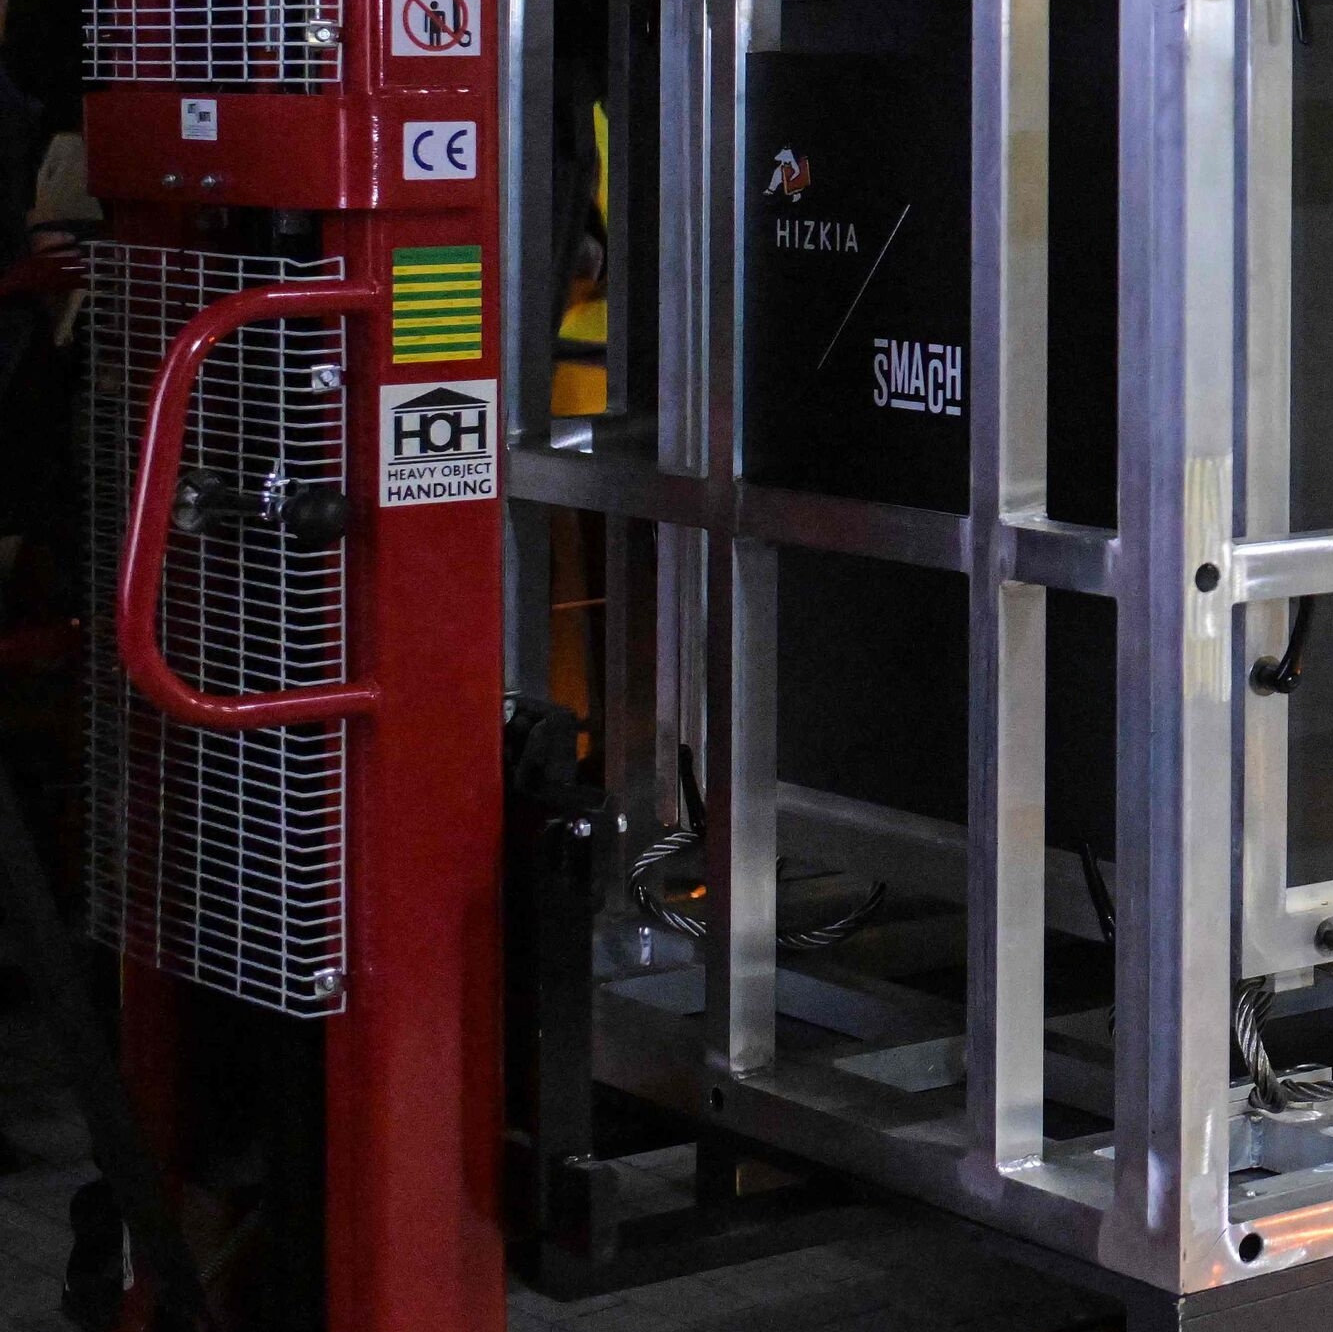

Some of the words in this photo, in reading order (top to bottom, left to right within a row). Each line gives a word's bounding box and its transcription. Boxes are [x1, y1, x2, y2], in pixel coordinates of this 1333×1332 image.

[412, 129, 468, 172] CE
[776, 218, 858, 253] HIZKIA
[873, 337, 962, 416] SMACH
[394, 409, 487, 456] HOH
[387, 467, 437, 482] HEAVY
[441, 462, 492, 479] OBJECT
[387, 478, 493, 502] HANDLING
